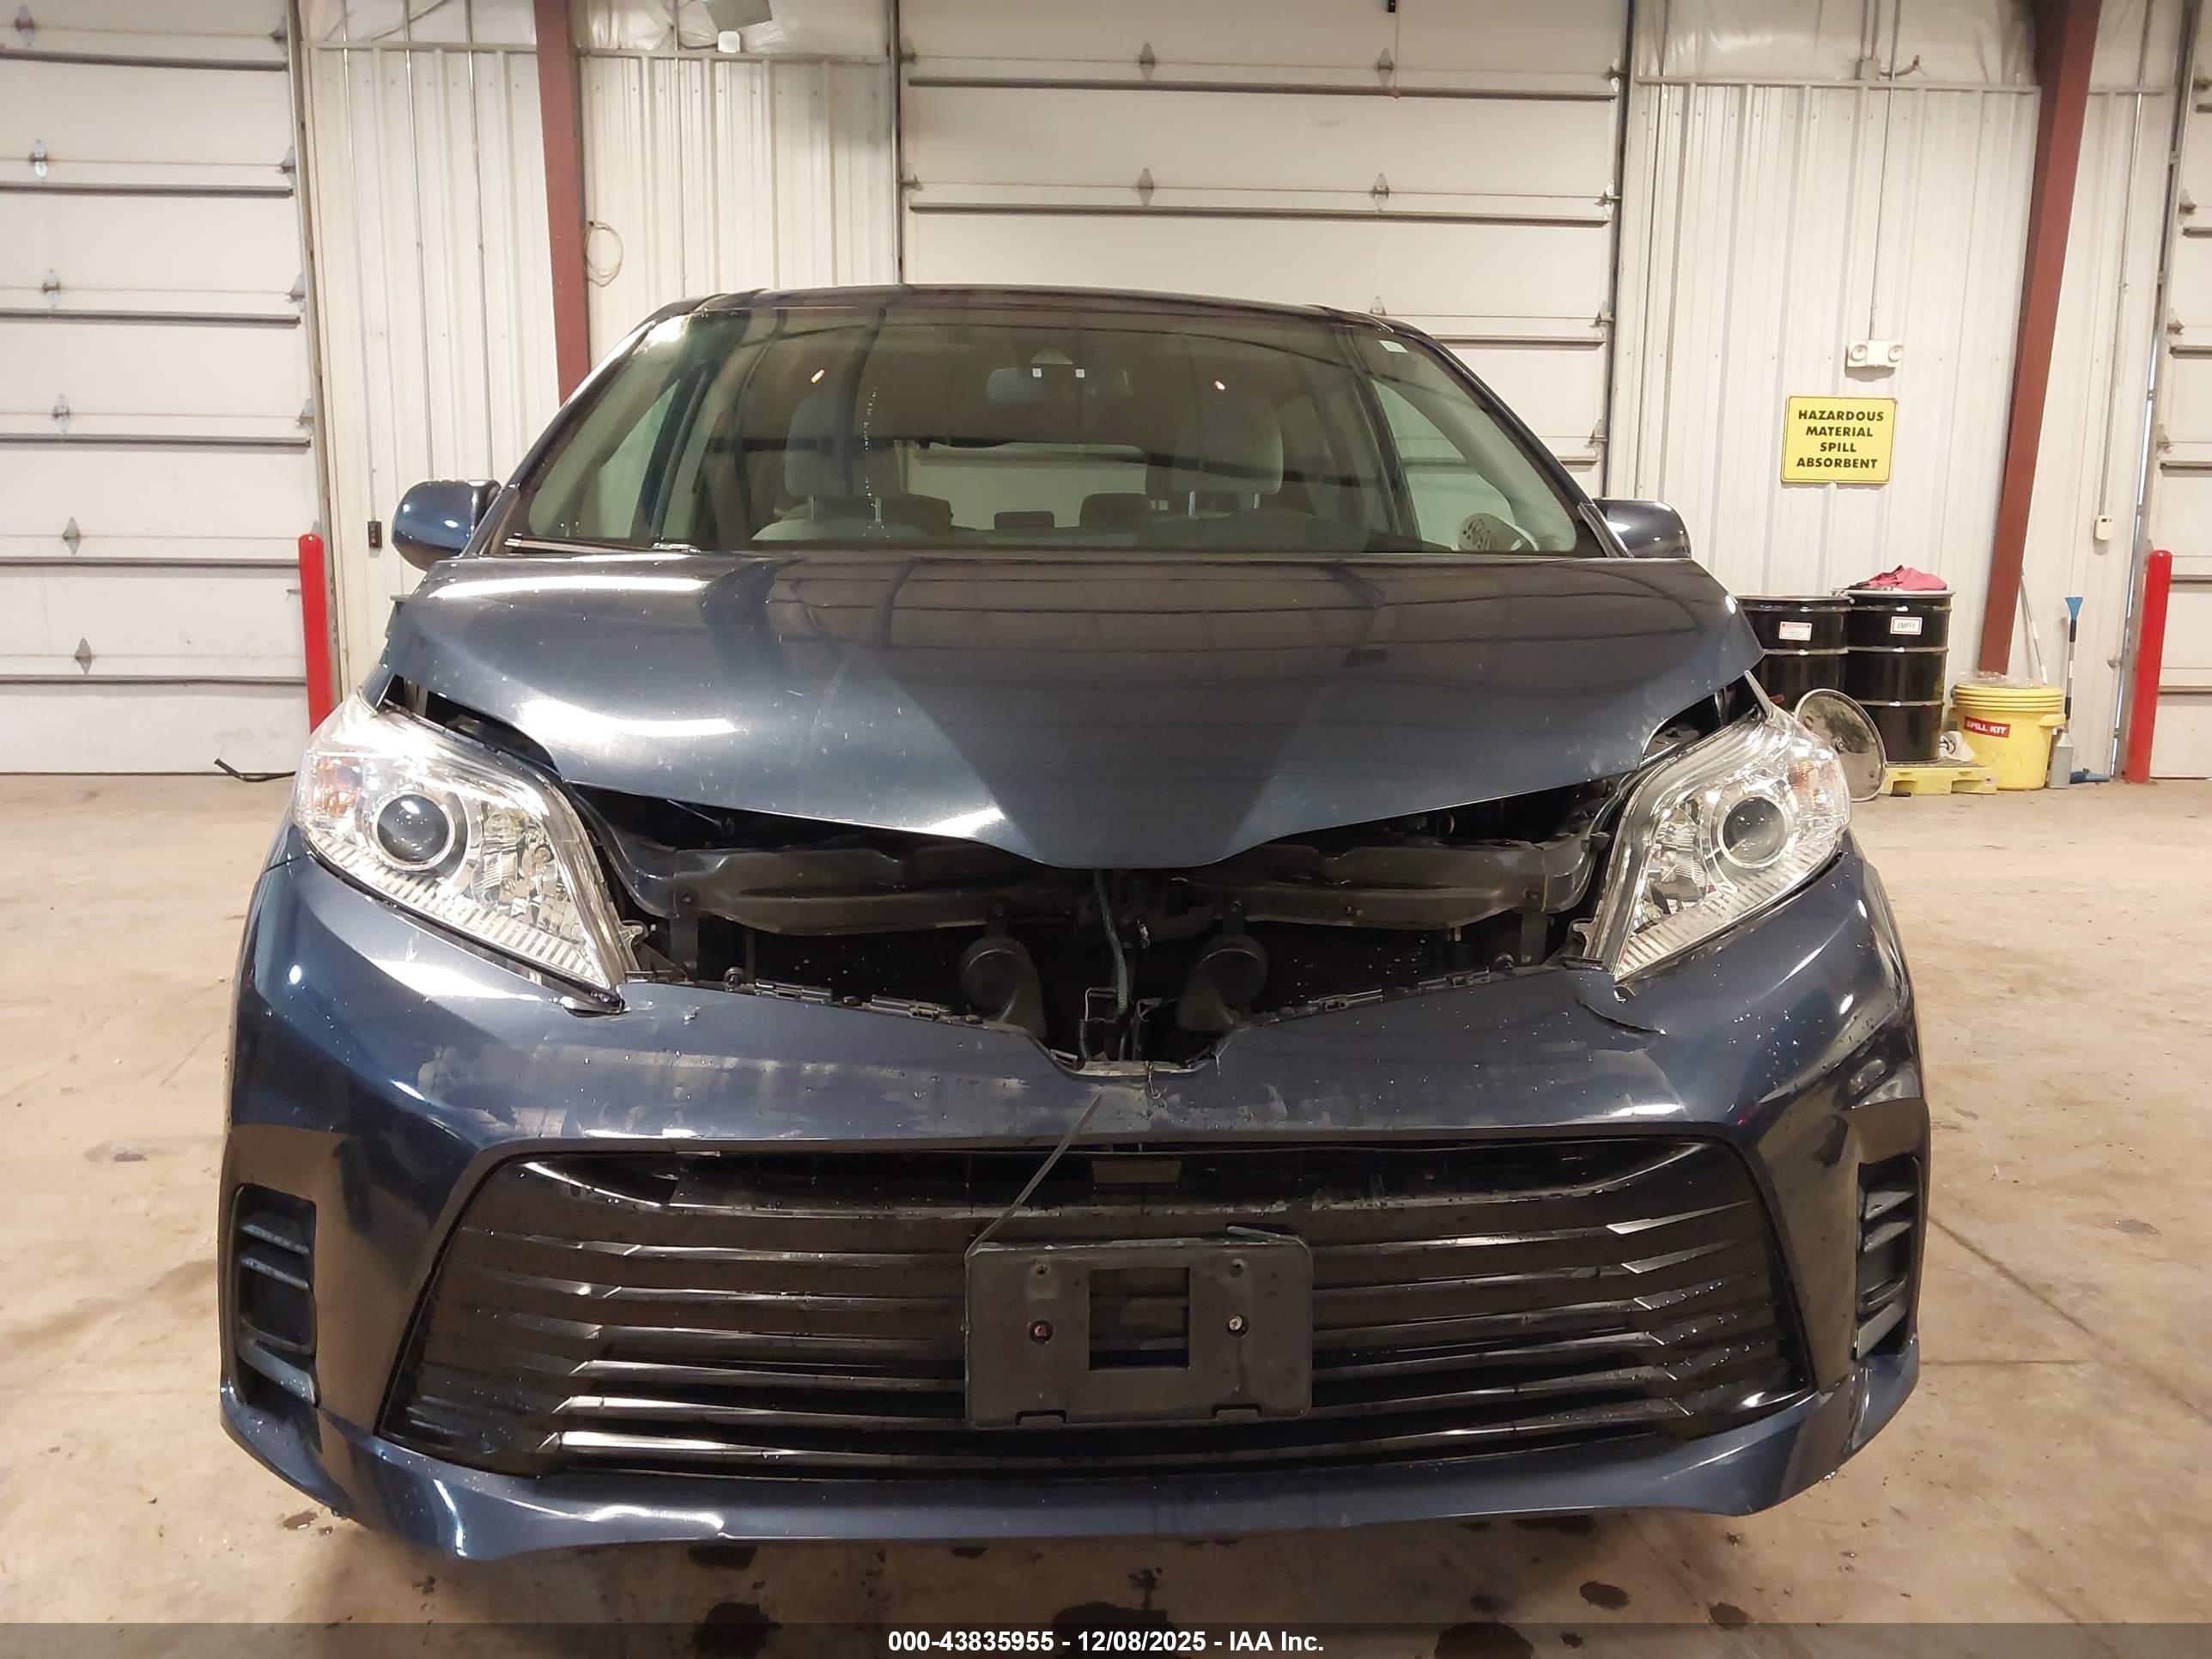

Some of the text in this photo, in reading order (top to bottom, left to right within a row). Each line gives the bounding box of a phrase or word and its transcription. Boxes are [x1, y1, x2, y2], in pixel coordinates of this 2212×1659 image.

[1798, 410, 1884, 422] HAZARDOUS
[1806, 426, 1874, 437] MATERIAL
[1820, 441, 1856, 453] SPILL
[1796, 458, 1878, 469] ABSORBENT
[1966, 720, 2007, 734] SPILL KIT
